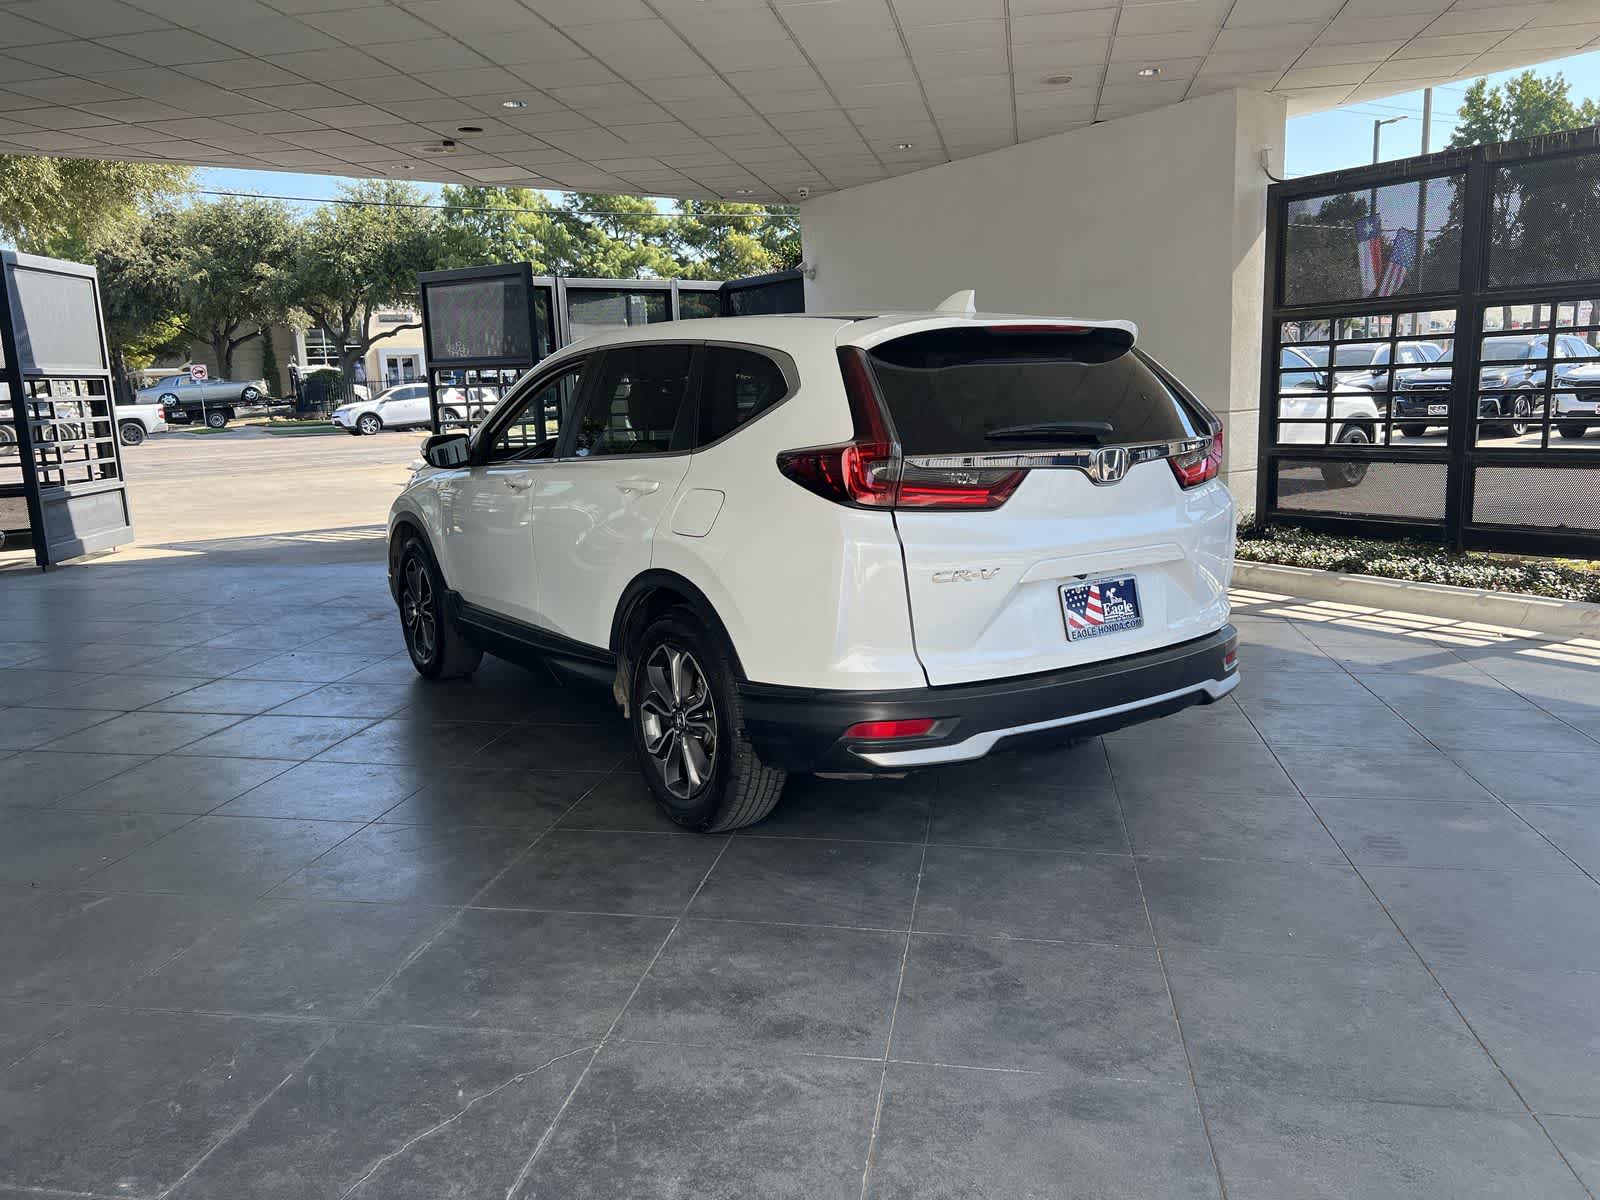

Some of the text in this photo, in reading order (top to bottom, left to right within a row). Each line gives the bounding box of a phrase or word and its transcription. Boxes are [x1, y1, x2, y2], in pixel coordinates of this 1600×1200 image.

[932, 568, 1000, 583] CR-V
[1102, 600, 1134, 617] Eagle
[1072, 627, 1097, 639] EAGLE
